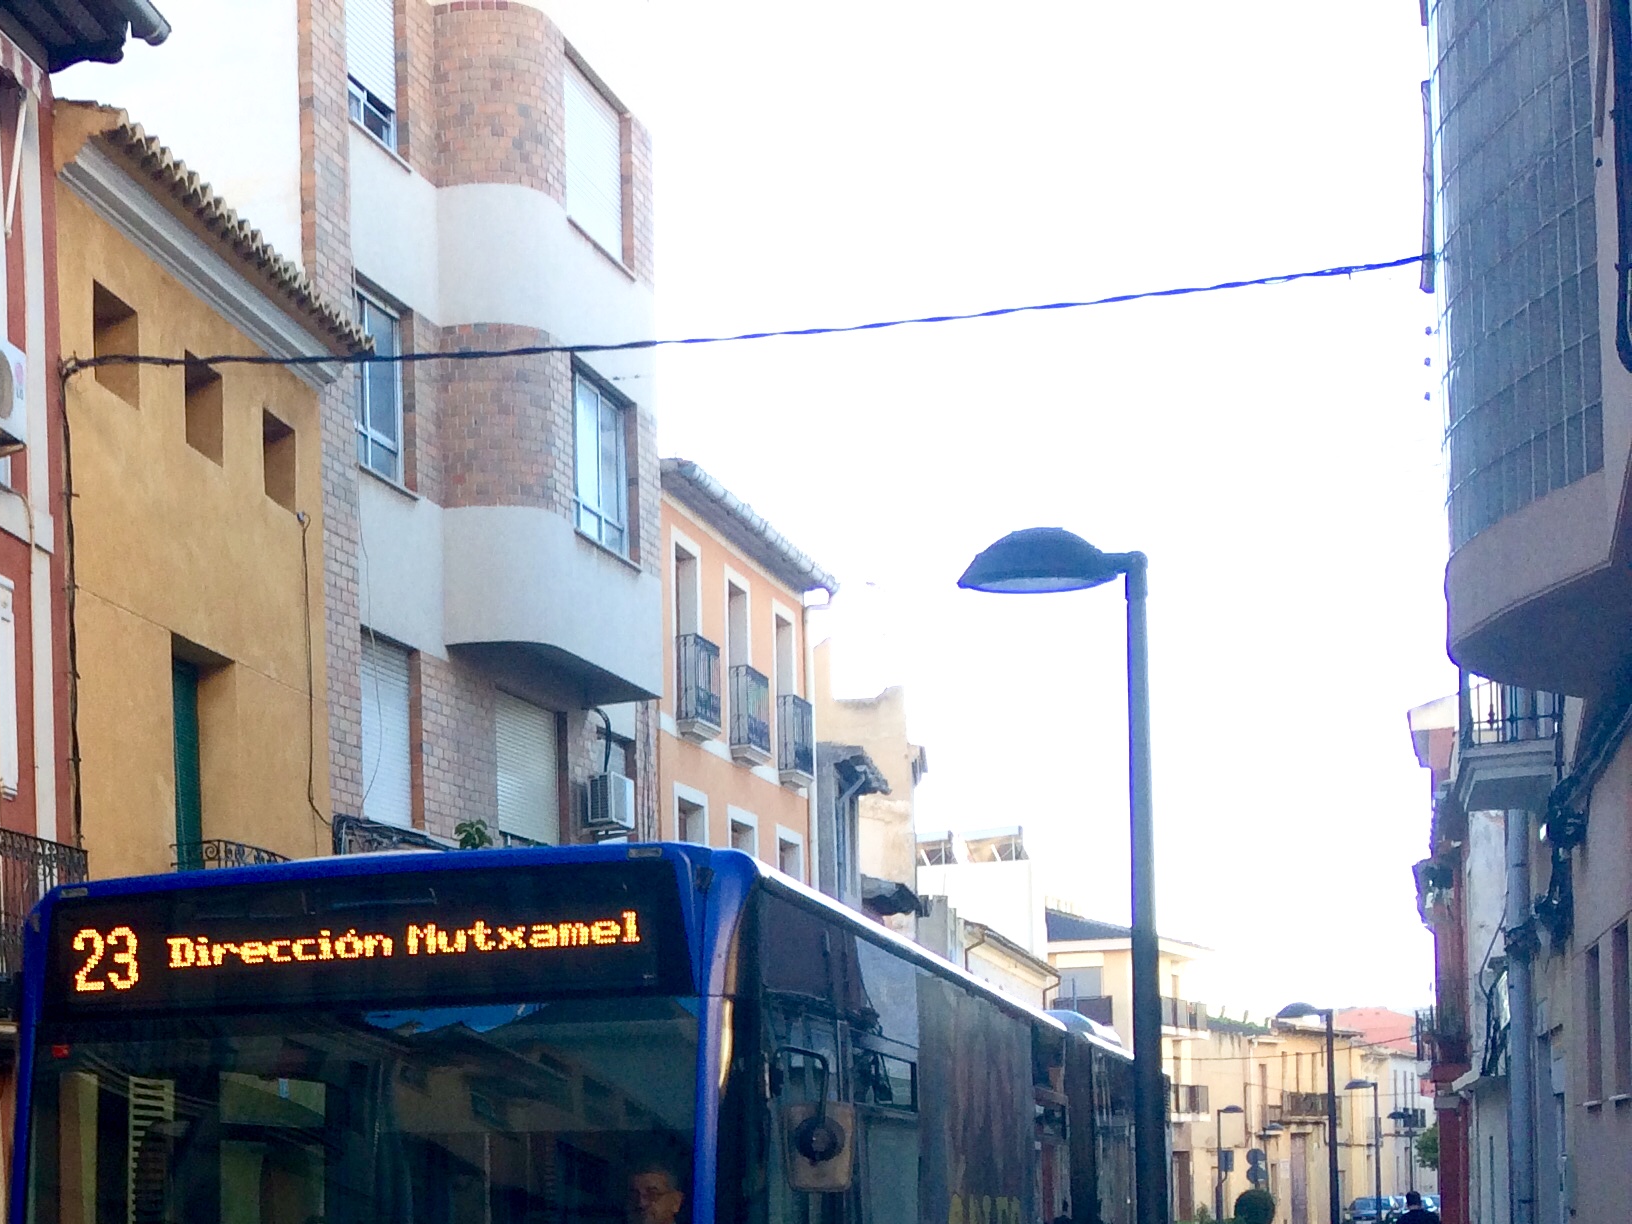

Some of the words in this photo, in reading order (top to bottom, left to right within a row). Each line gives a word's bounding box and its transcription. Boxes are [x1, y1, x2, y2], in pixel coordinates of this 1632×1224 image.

[73, 926, 139, 992] 23
[167, 928, 393, 968] Dirección
[407, 910, 641, 956] Mutxamel
